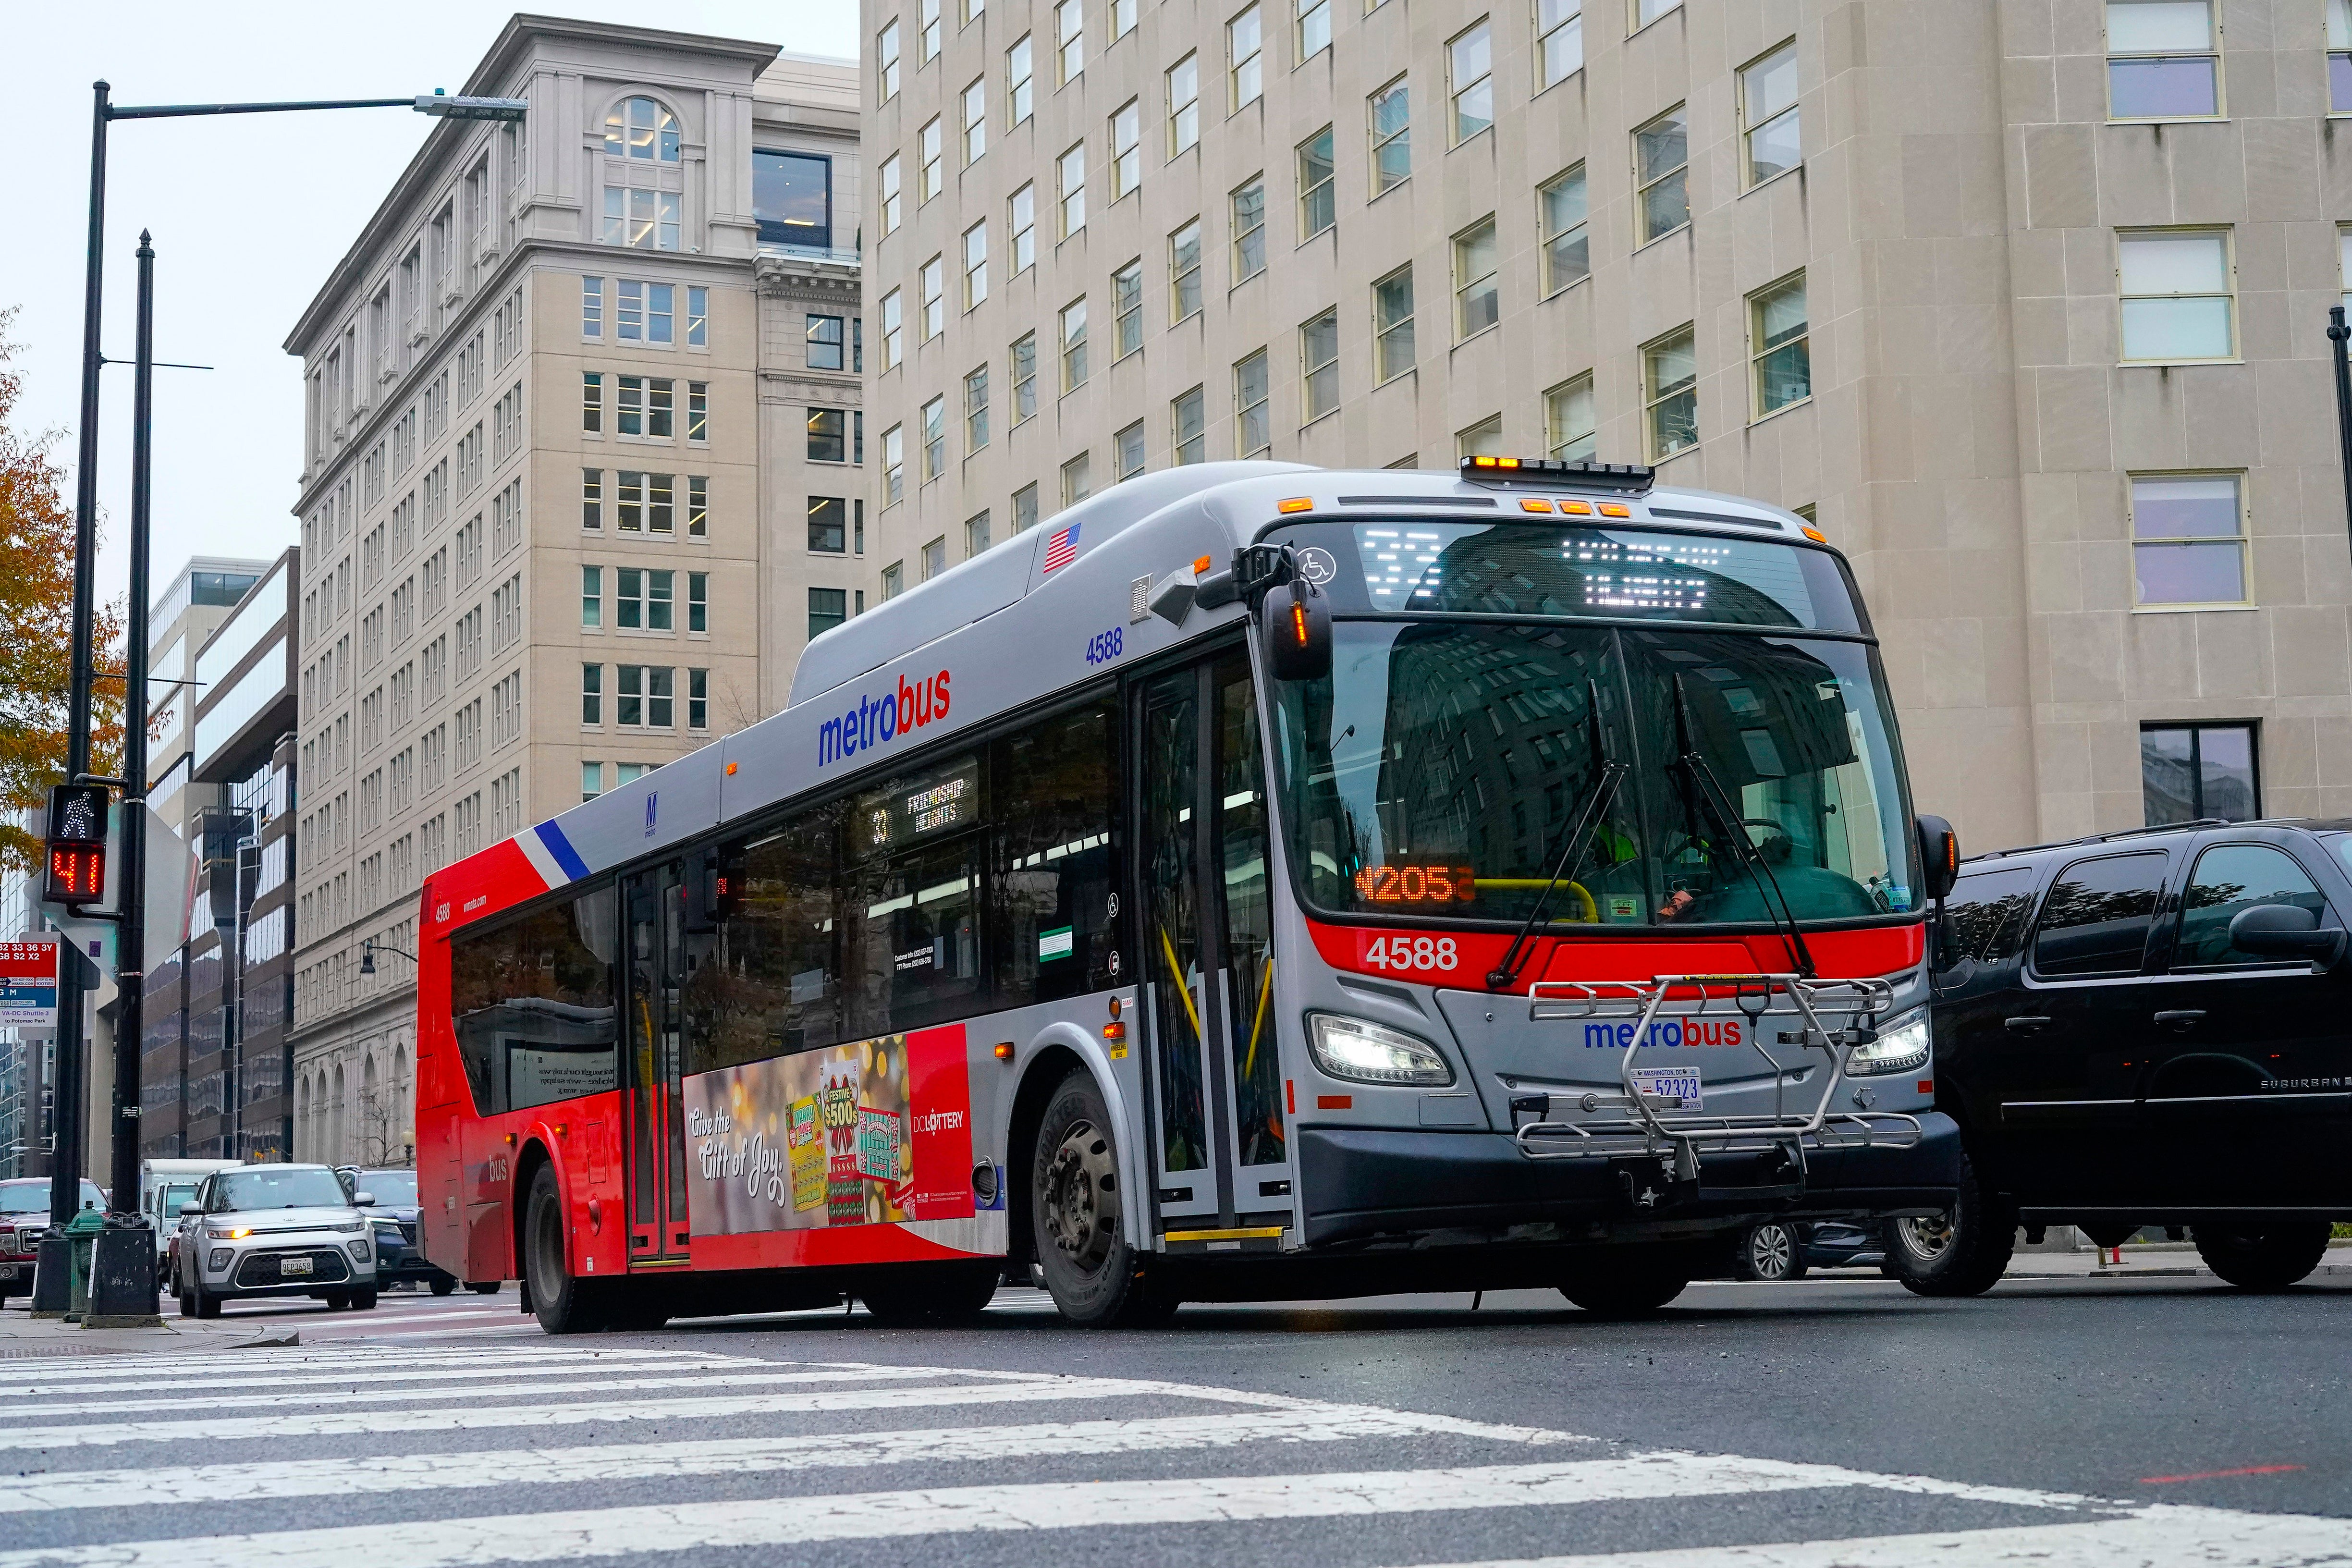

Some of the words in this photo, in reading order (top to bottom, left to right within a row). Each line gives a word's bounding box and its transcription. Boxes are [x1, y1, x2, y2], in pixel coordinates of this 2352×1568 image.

[1086, 626, 1123, 665] 4588
[819, 669, 950, 767] metrobus
[908, 779, 964, 814] FRIENDSHIP
[873, 809, 887, 844] 33
[916, 803, 956, 833] HEIGHTS
[645, 828, 656, 839] metro
[54, 852, 98, 894] 41
[436, 902, 450, 923] 4588
[464, 895, 486, 913] wmata.com
[1366, 937, 1458, 970] 4588
[1111, 1043, 1127, 1052] KNEELING
[829, 1088, 850, 1101] FESTIVE
[2261, 1078, 2341, 1089] SUBURBAN
[689, 1107, 713, 1137] Give
[715, 1106, 731, 1134] the
[824, 1100, 858, 1128] $500s
[489, 1154, 507, 1182] bus
[698, 1138, 729, 1180] Gift
[732, 1137, 748, 1176] of
[747, 1131, 786, 1208] Joy.
